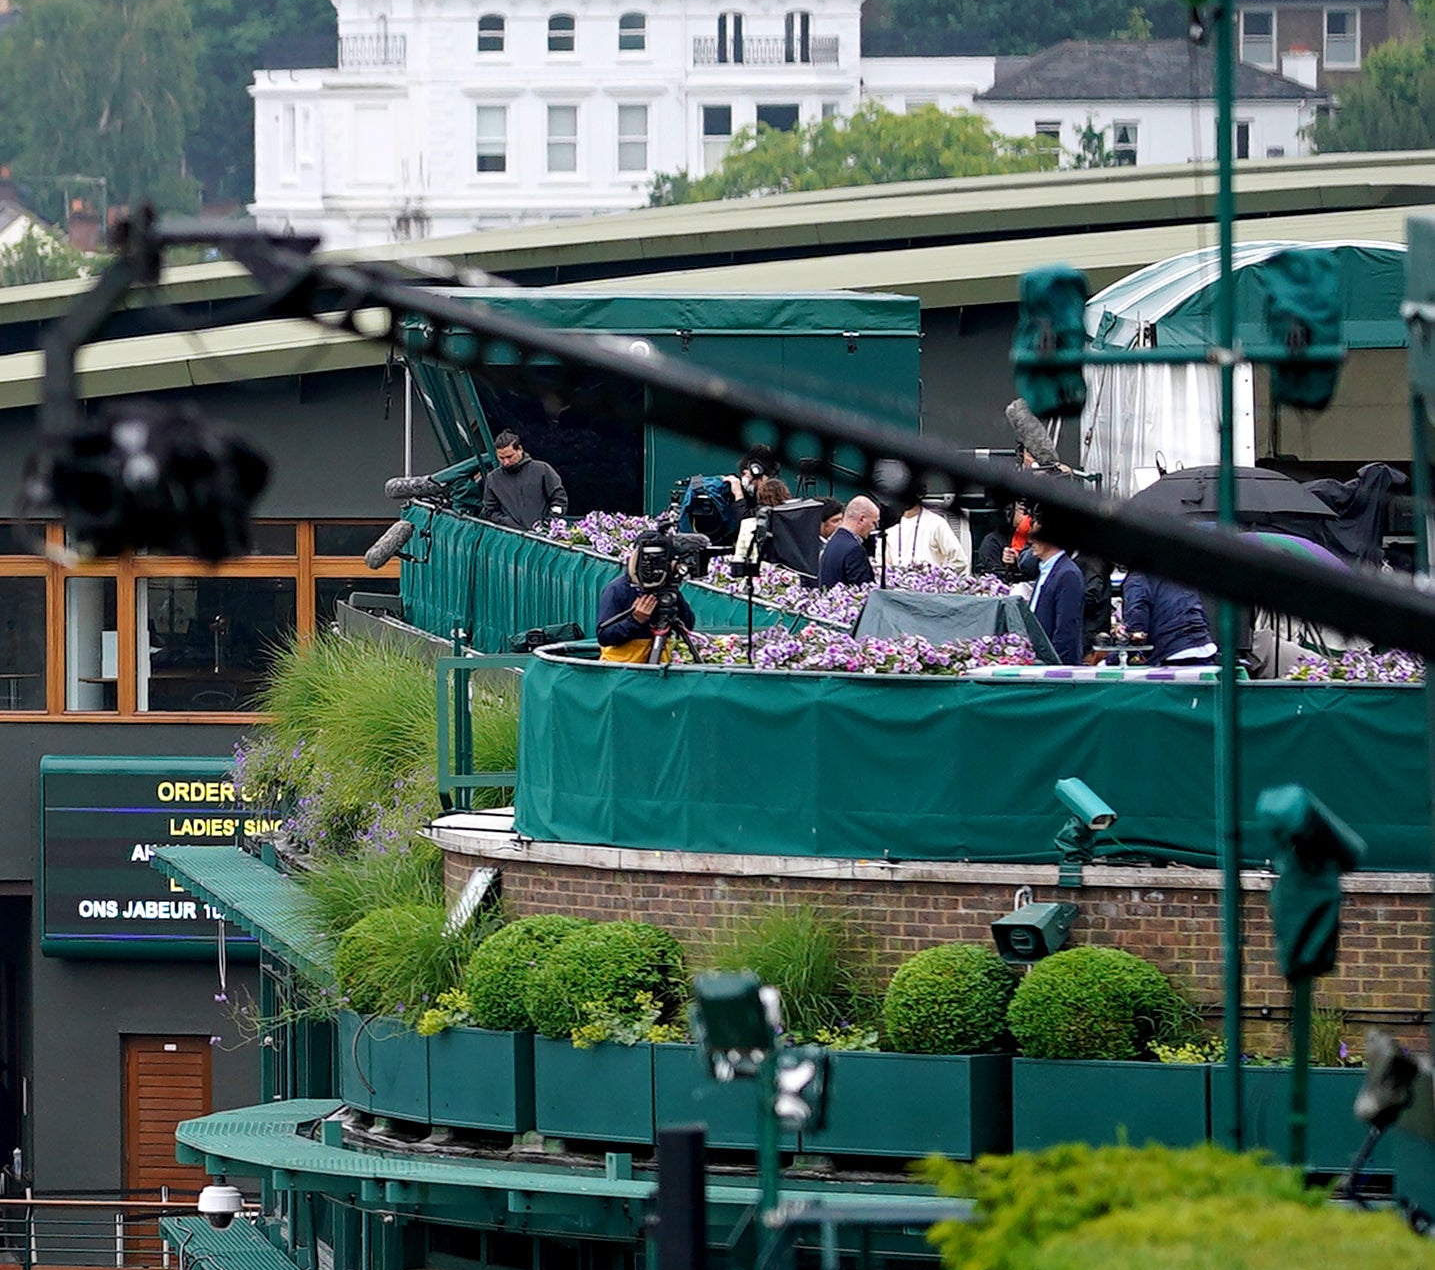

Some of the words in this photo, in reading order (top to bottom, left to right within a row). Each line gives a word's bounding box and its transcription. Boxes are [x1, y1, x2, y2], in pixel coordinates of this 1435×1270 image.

[157, 782, 235, 802] ORDER
[169, 818, 238, 837] LADIES'
[78, 901, 118, 918] ONS
[122, 902, 197, 919] JABEUR
